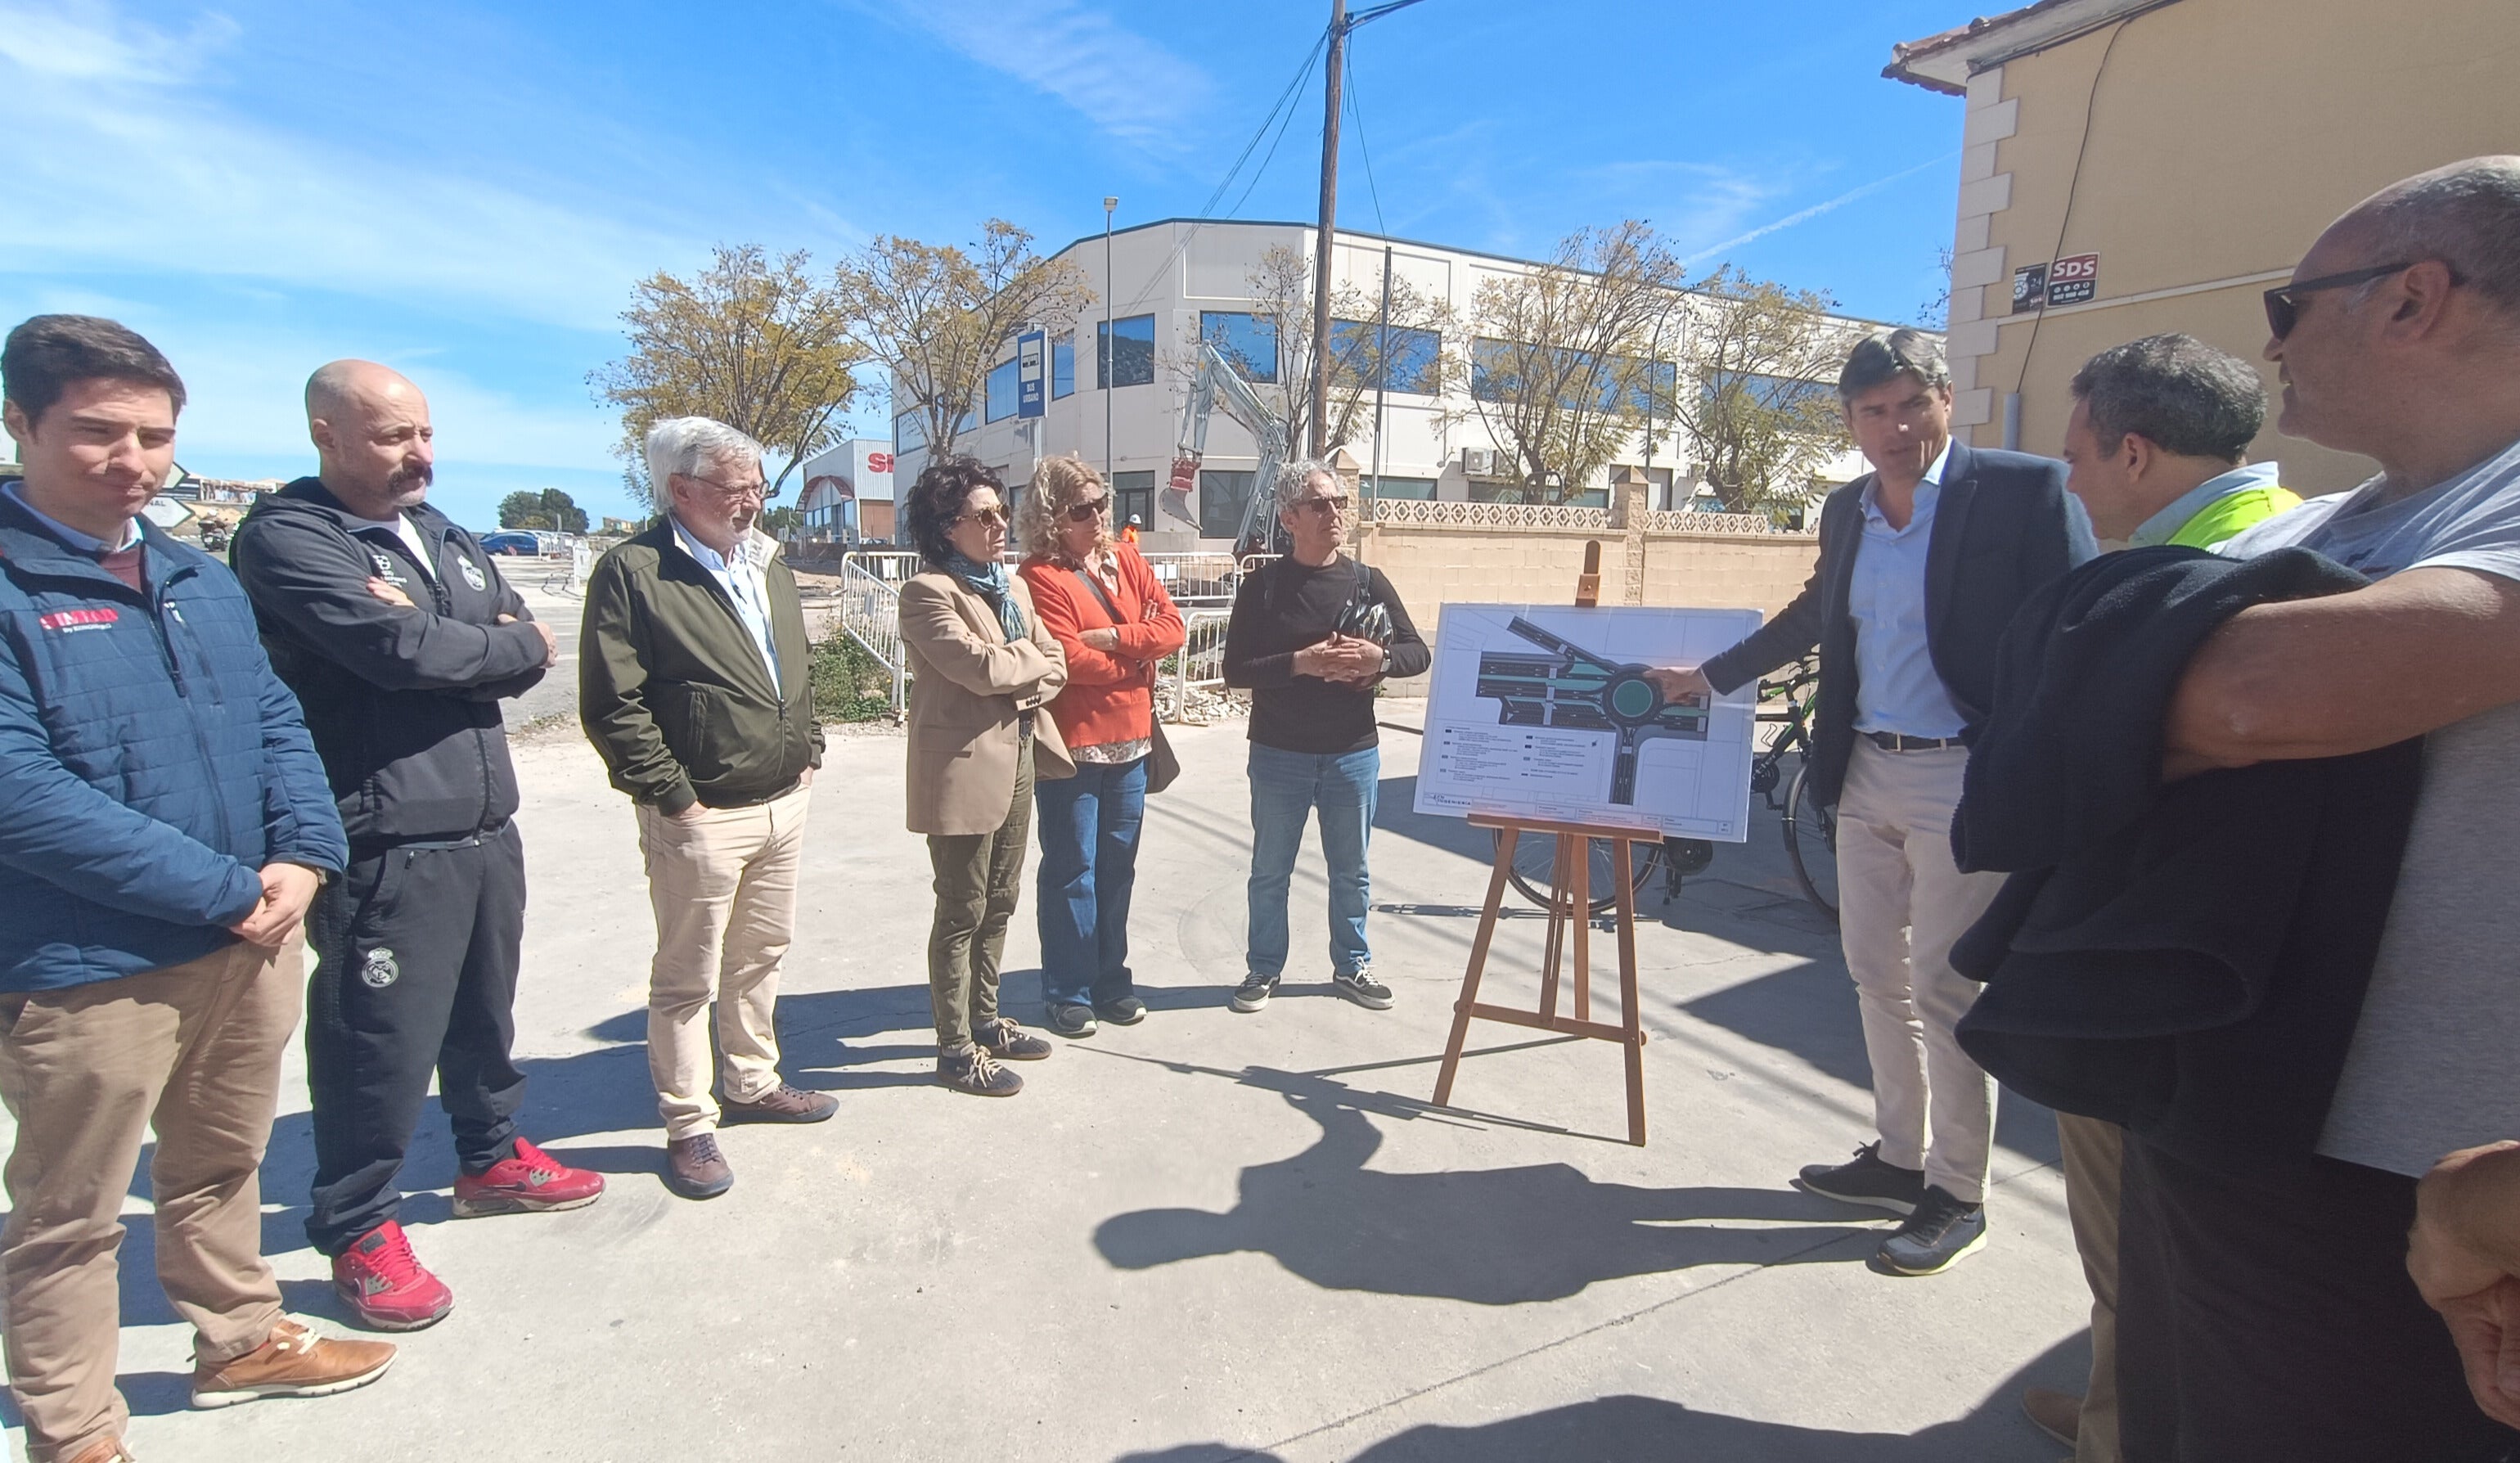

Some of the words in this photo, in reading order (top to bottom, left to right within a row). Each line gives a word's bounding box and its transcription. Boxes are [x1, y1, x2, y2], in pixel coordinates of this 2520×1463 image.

[2052, 260, 2095, 277] SDS
[2030, 277, 2042, 287] 24
[1027, 382, 1035, 393] BUS
[1023, 393, 1039, 403] URBANO
